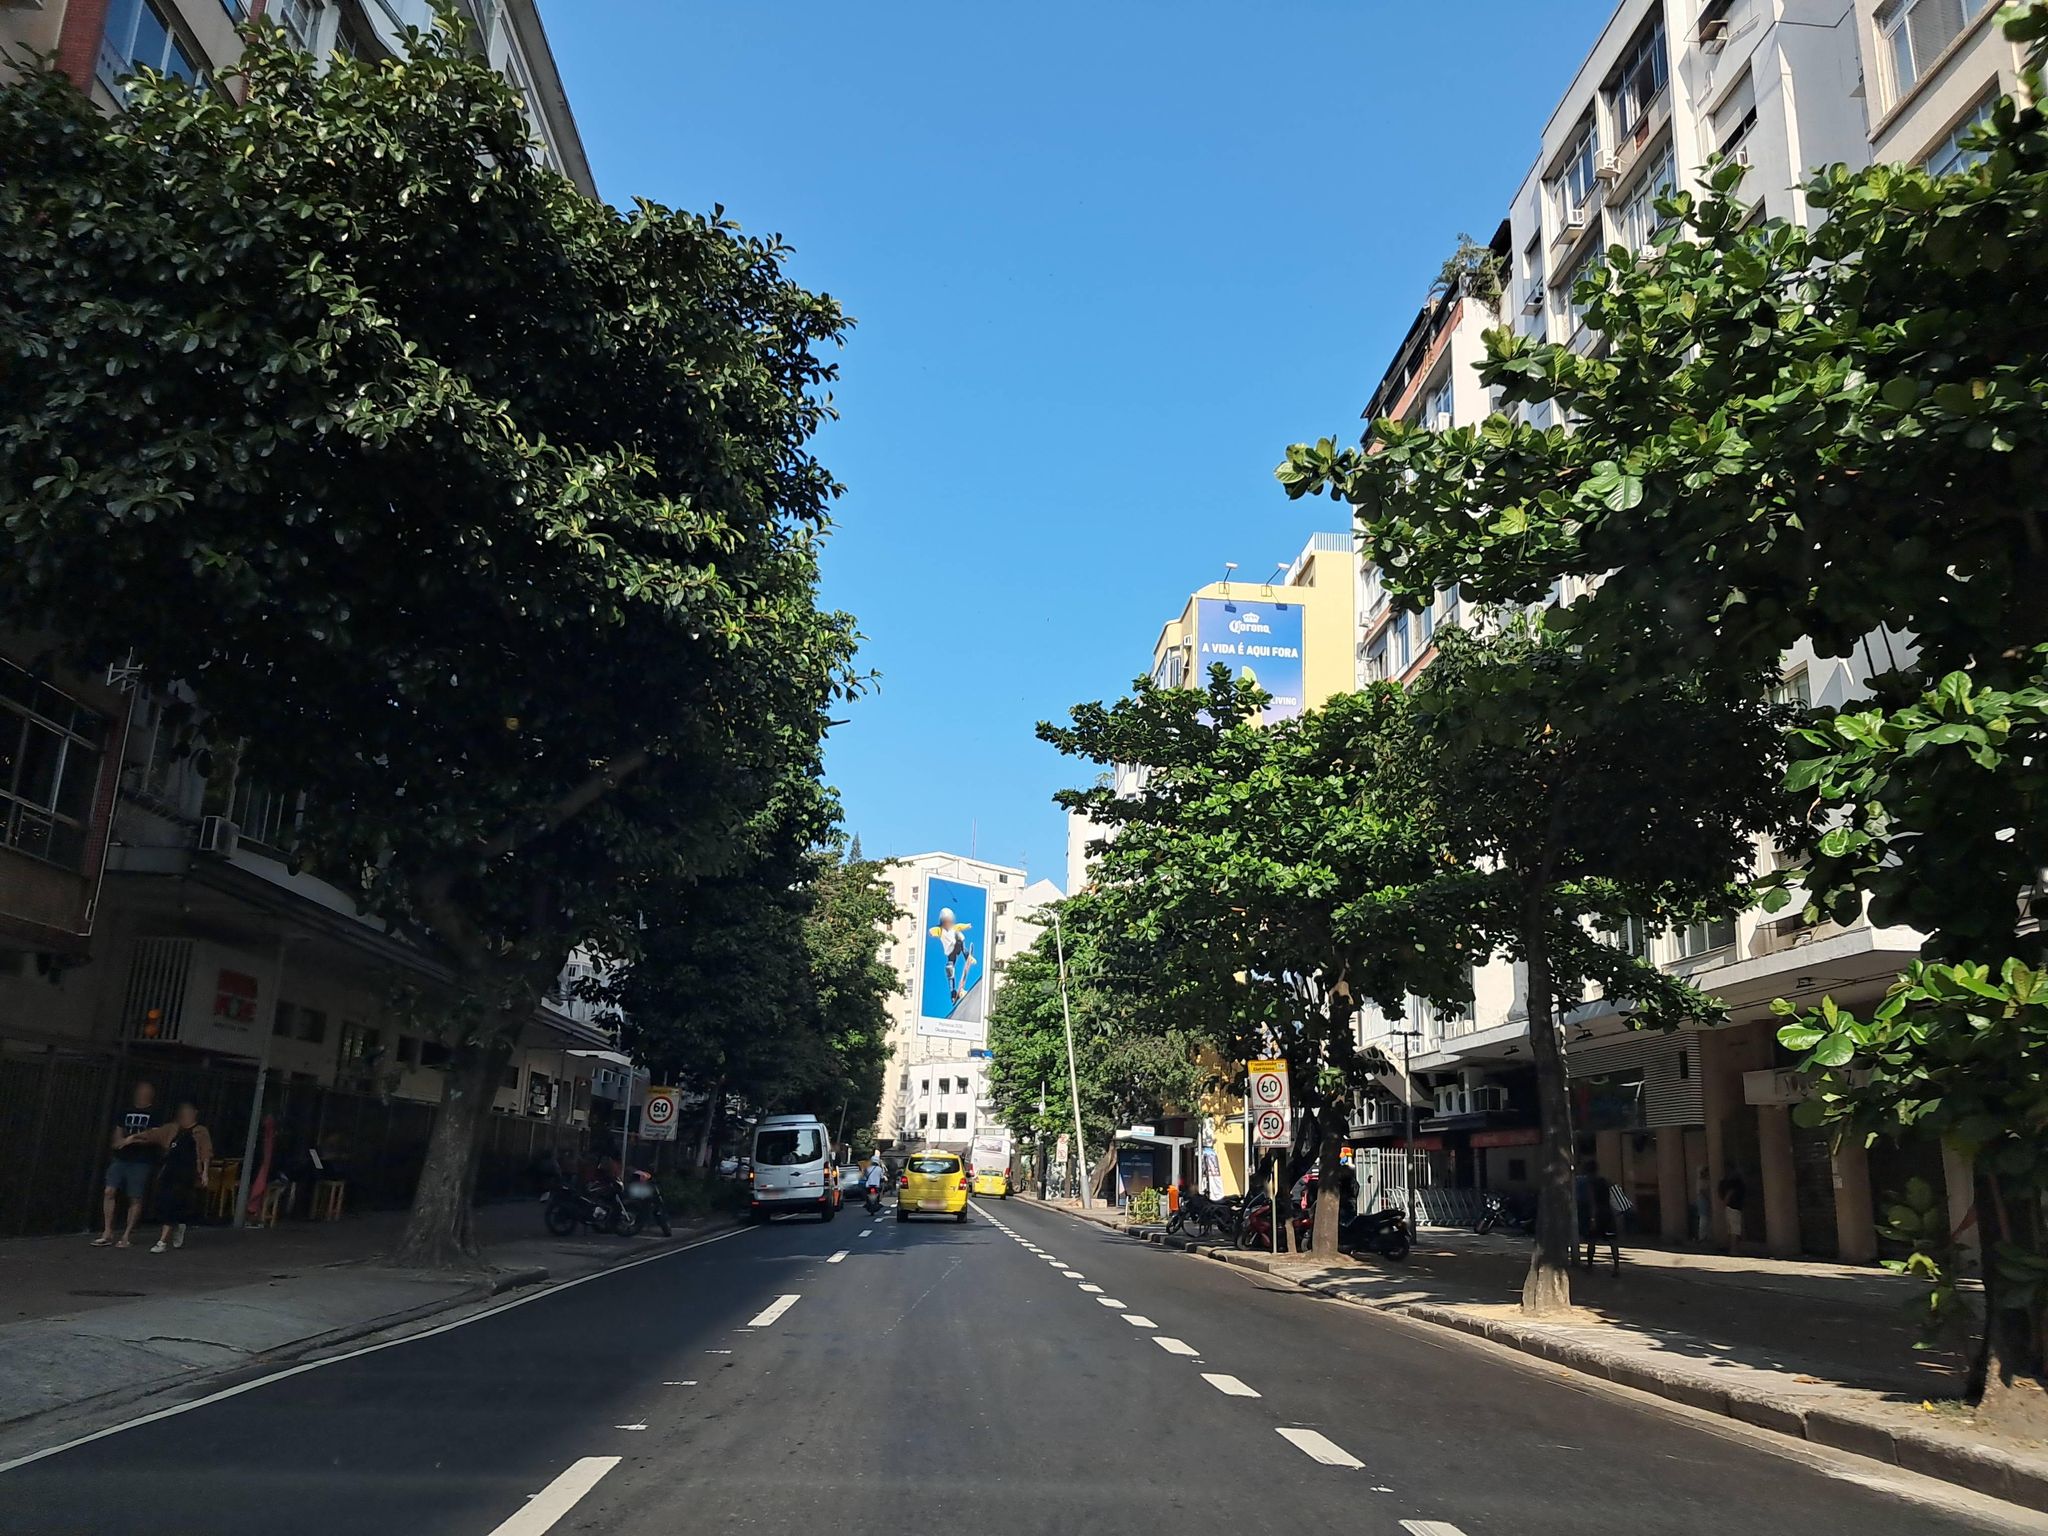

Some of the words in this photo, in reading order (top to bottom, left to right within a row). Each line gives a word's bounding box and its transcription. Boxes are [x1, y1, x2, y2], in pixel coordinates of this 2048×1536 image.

[1229, 619, 1271, 634] Corona
[1202, 643, 1210, 652] A
[1212, 643, 1235, 654] VIDA
[1237, 642, 1244, 655] É
[1246, 645, 1270, 658] AQUI
[1272, 646, 1299, 658] FORA
[1261, 1080, 1277, 1093] 60
[653, 1102, 668, 1113] 60
[1262, 1117, 1279, 1130] 50
